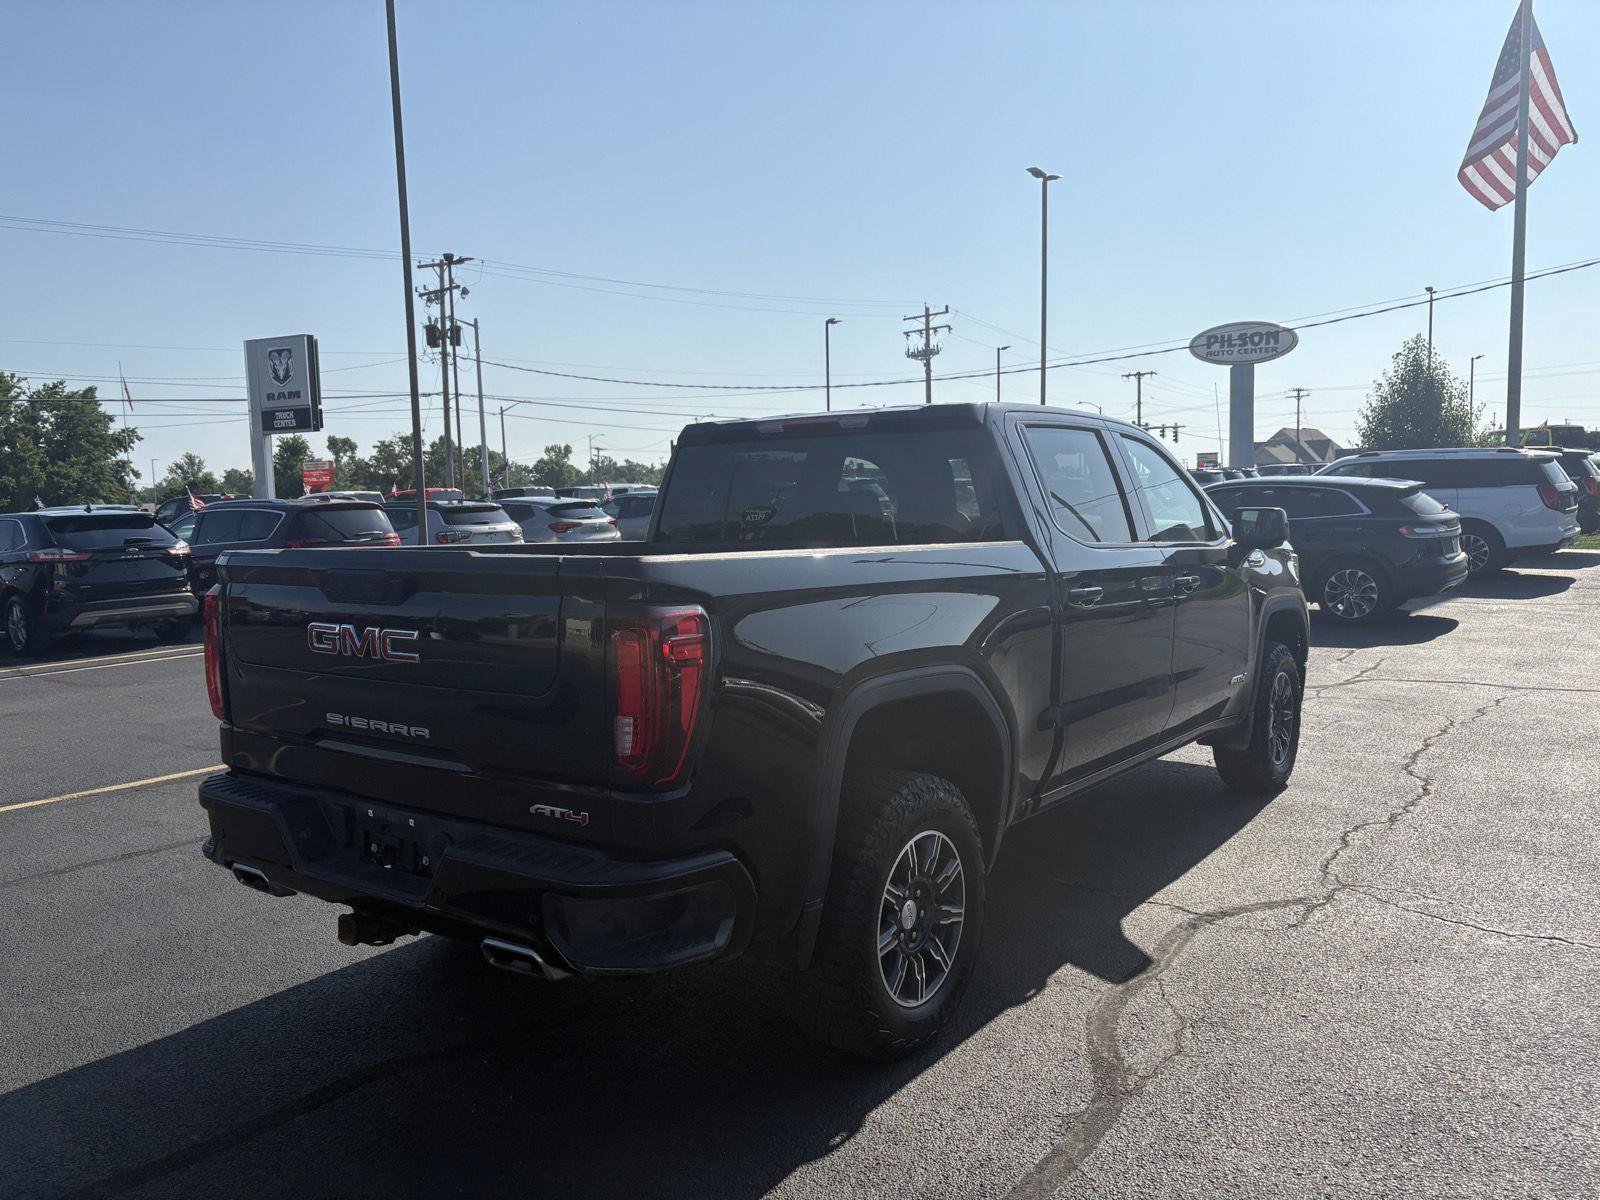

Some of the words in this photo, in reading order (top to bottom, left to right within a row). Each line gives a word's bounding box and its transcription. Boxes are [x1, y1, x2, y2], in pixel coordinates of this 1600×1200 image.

[1205, 330, 1280, 350] PILSON
[1205, 348, 1234, 358] AUTO
[1237, 346, 1279, 356] CENTER
[266, 390, 301, 402] RAM
[273, 418, 297, 428] CENTER
[274, 410, 295, 420] TRUCK
[307, 621, 421, 664] GMC
[325, 712, 431, 740] SIERRA
[529, 803, 590, 828] AT4
